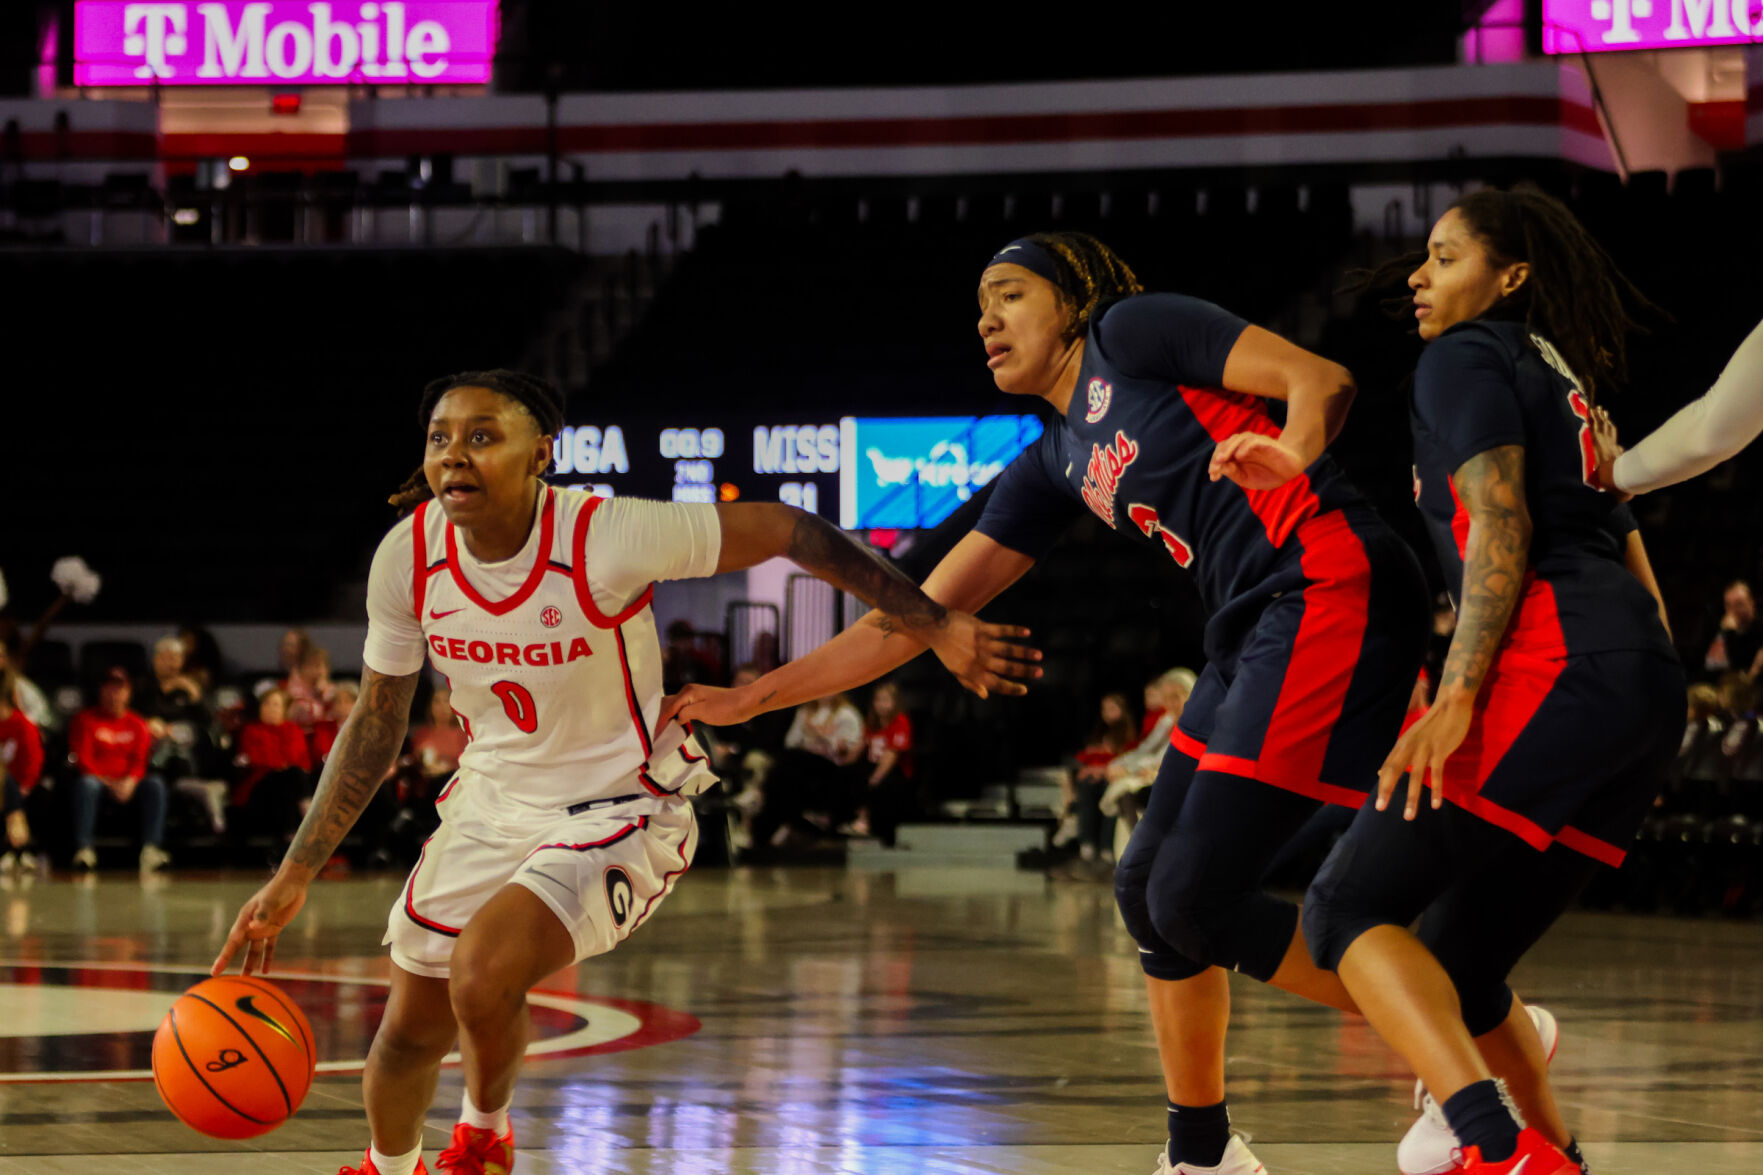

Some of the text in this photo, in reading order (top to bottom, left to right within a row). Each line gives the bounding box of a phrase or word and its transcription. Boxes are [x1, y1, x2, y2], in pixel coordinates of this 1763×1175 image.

[197, 3, 450, 78] Mobile
[1663, 0, 1763, 40] M
[553, 425, 629, 474] UGA
[753, 424, 840, 474] MISS
[542, 607, 560, 626] SEC
[428, 634, 594, 667] GEORGIA
[490, 679, 538, 734] 0
[603, 865, 633, 930] G
